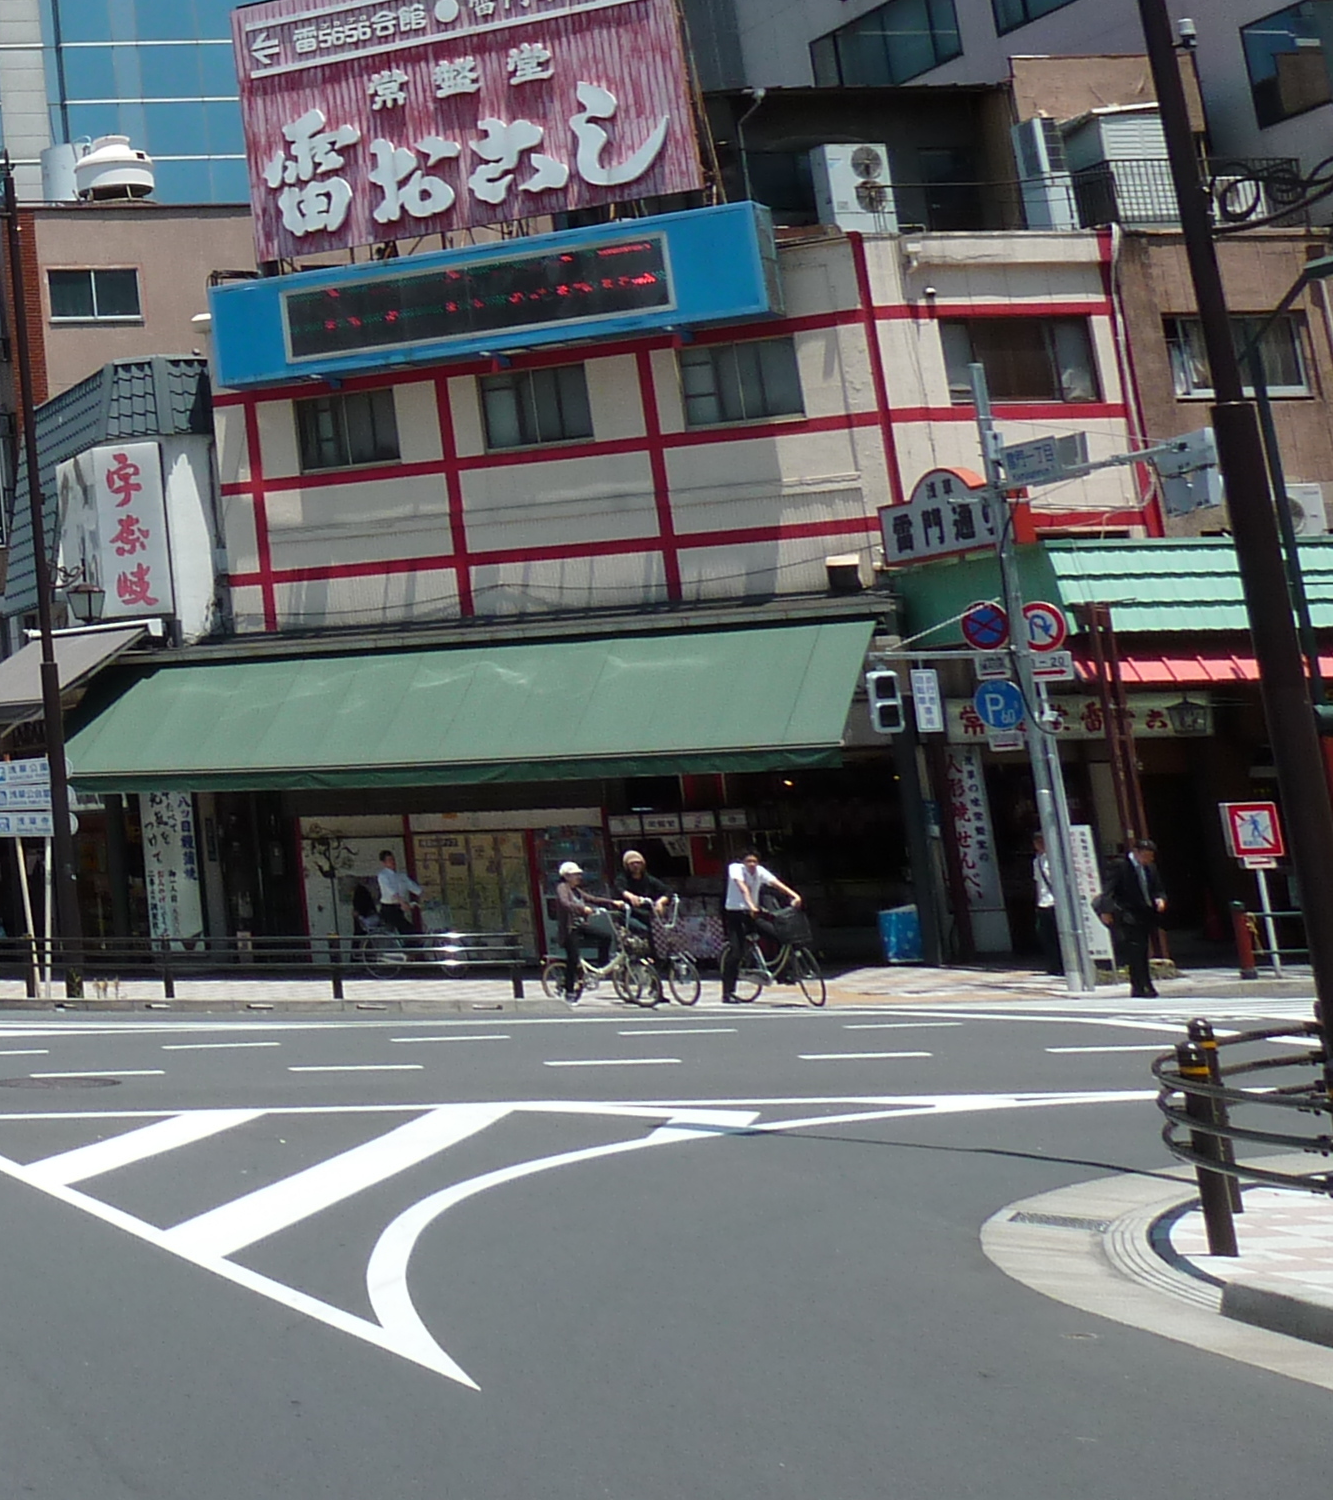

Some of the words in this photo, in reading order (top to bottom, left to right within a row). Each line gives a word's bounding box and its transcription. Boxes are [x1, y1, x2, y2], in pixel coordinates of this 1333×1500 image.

[293, 3, 427, 55] 雷5656会館
[367, 41, 555, 111] 常盤堂
[926, 477, 953, 501] 浅草
[985, 693, 1004, 725] P
[1001, 709, 1016, 724] 60
